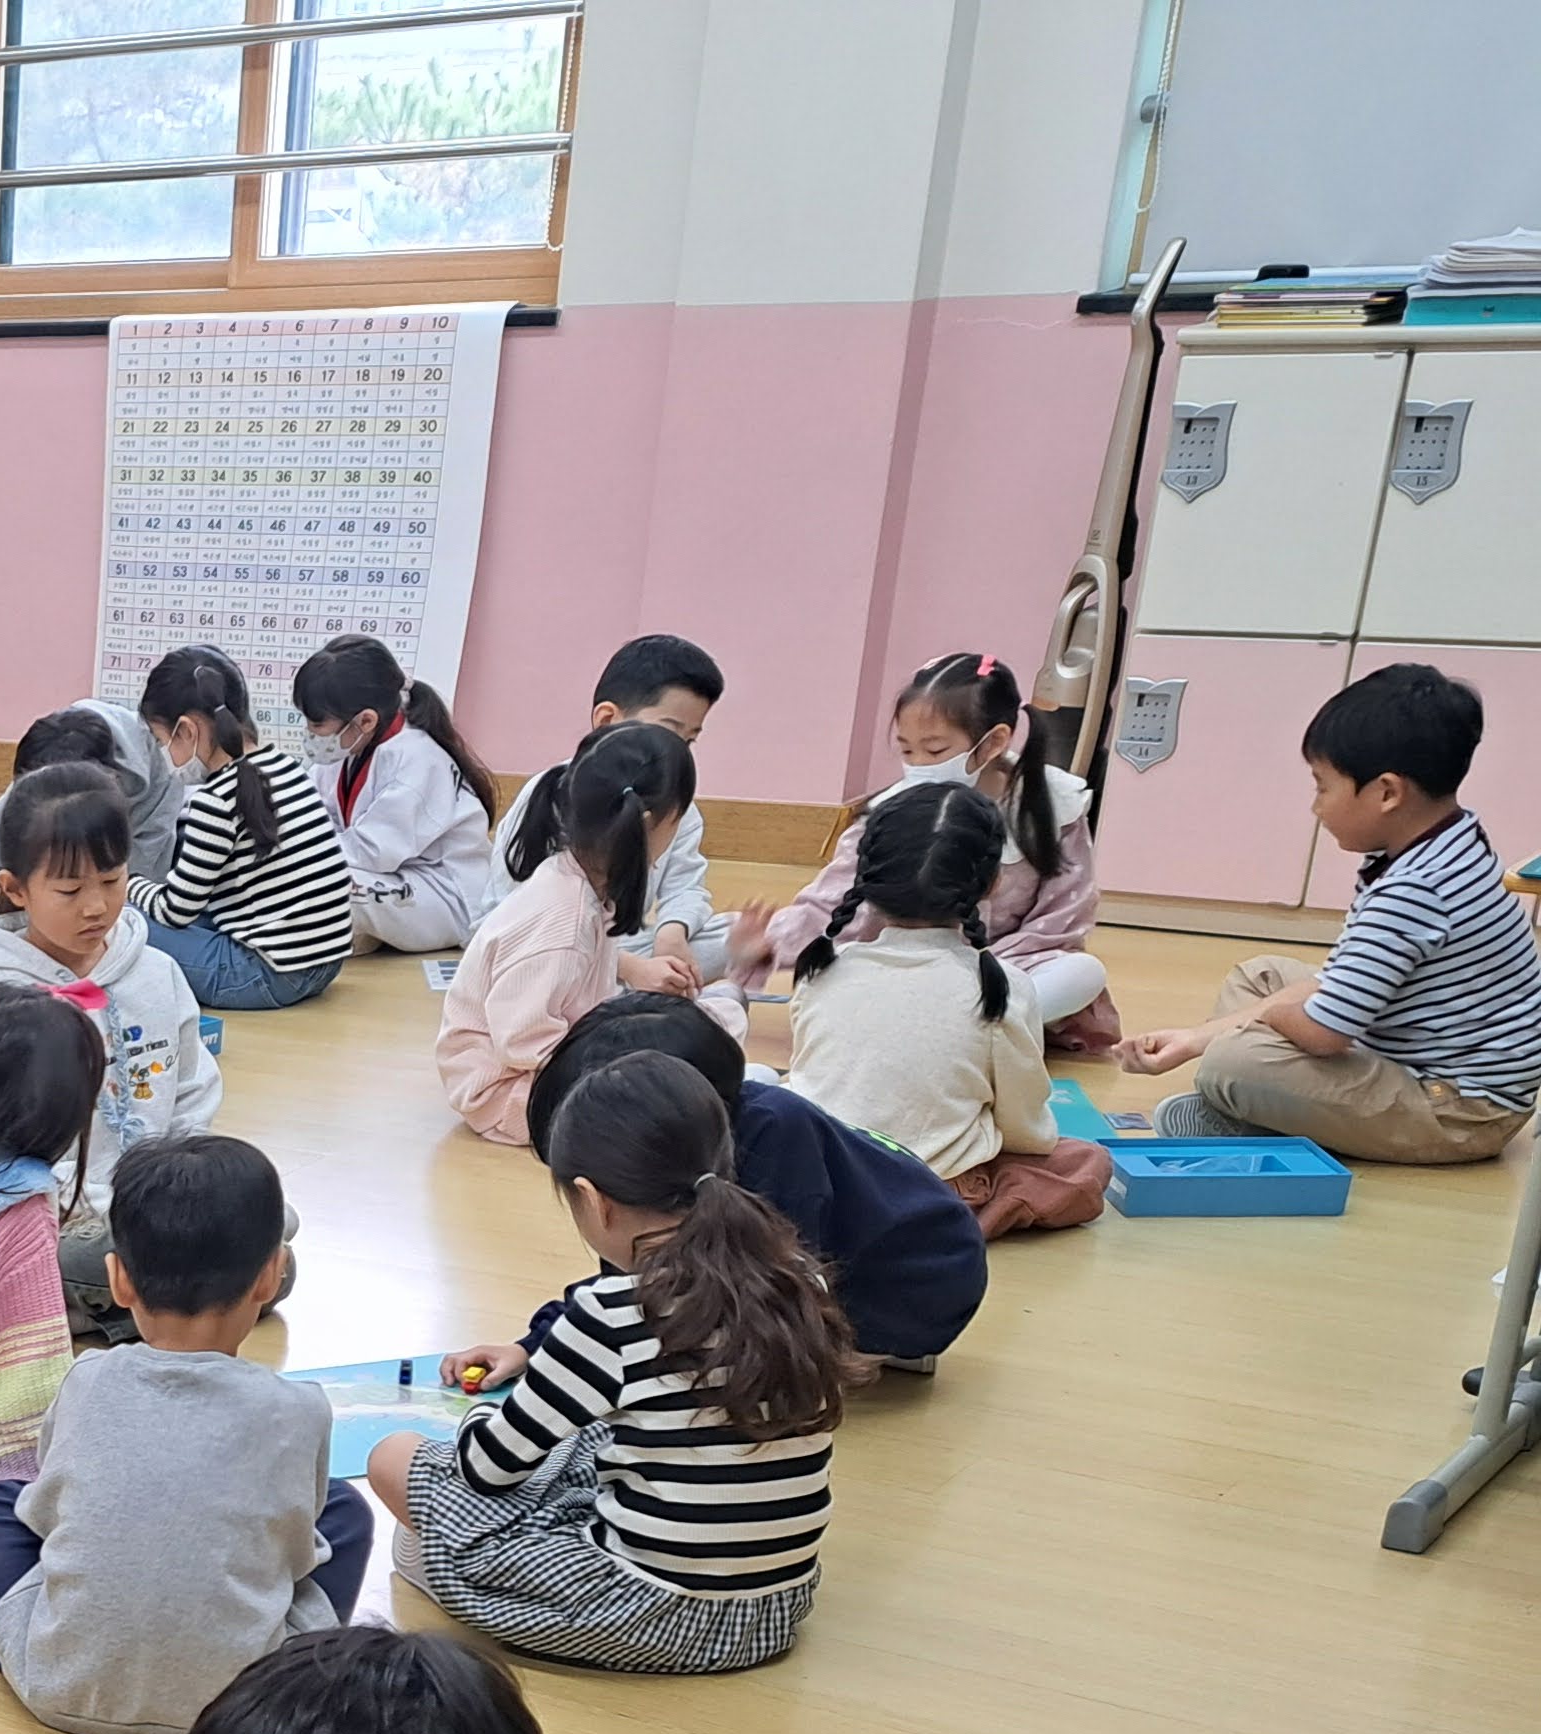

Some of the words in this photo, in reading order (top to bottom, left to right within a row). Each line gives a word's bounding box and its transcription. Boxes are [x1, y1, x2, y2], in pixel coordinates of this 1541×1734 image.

[133, 324, 137, 336] 1
[164, 323, 172, 335] 2
[196, 322, 204, 334] 3
[229, 322, 236, 332] 4
[262, 321, 269, 332] 5
[295, 320, 304, 332] 6
[331, 319, 339, 331] 7
[364, 318, 373, 330] 8
[400, 317, 409, 329] 9
[433, 316, 449, 328] 10
[127, 373, 137, 384] 11
[159, 372, 171, 384] 12
[190, 372, 202, 384] 13
[222, 372, 233, 382] 14
[254, 371, 267, 383] 15
[289, 370, 301, 382] 16
[323, 370, 335, 382] 17
[357, 369, 370, 381] 18
[391, 369, 405, 381] 19
[424, 368, 442, 380] 20
[123, 421, 134, 433] 21
[153, 421, 168, 432] 22
[185, 421, 199, 433] 23
[215, 421, 229, 432] 24
[247, 421, 263, 432] 25
[281, 420, 297, 432] 26
[316, 420, 331, 432] 27
[349, 420, 366, 432] 28
[385, 420, 401, 432] 29
[419, 420, 437, 432] 30
[121, 470, 131, 481] 31
[149, 470, 164, 481] 32
[181, 470, 195, 482] 33
[211, 470, 225, 482] 34
[243, 470, 257, 482] 35
[276, 471, 291, 482] 36
[311, 470, 326, 482] 37
[344, 471, 361, 483] 38
[379, 471, 396, 483] 39
[414, 471, 432, 483] 40
[119, 517, 129, 528] 41
[145, 518, 160, 529] 42
[177, 518, 191, 530] 43
[208, 519, 221, 530] 44
[238, 520, 253, 531] 45
[270, 520, 286, 532] 46
[304, 520, 321, 531] 47
[338, 521, 355, 532] 48
[373, 521, 390, 533] 49
[409, 522, 426, 534] 50
[116, 564, 126, 575] 51
[143, 565, 157, 576] 52
[173, 566, 187, 577] 53
[204, 567, 217, 578] 54
[235, 568, 249, 579] 55
[266, 568, 280, 580] 56
[299, 570, 314, 581] 57
[333, 570, 349, 582] 58
[367, 571, 384, 583] 59
[401, 572, 420, 584] 60
[113, 610, 124, 621] 61
[141, 611, 155, 622] 62
[170, 612, 184, 624] 63
[200, 614, 213, 625] 64
[231, 615, 245, 627] 65
[262, 616, 277, 628] 66
[294, 618, 308, 629] 67
[326, 619, 342, 631] 68
[360, 620, 377, 632] 69
[395, 621, 412, 633] 70
[111, 656, 121, 666] 71
[139, 658, 151, 669] 72
[259, 664, 272, 676] 76
[288, 712, 303, 723] 87
